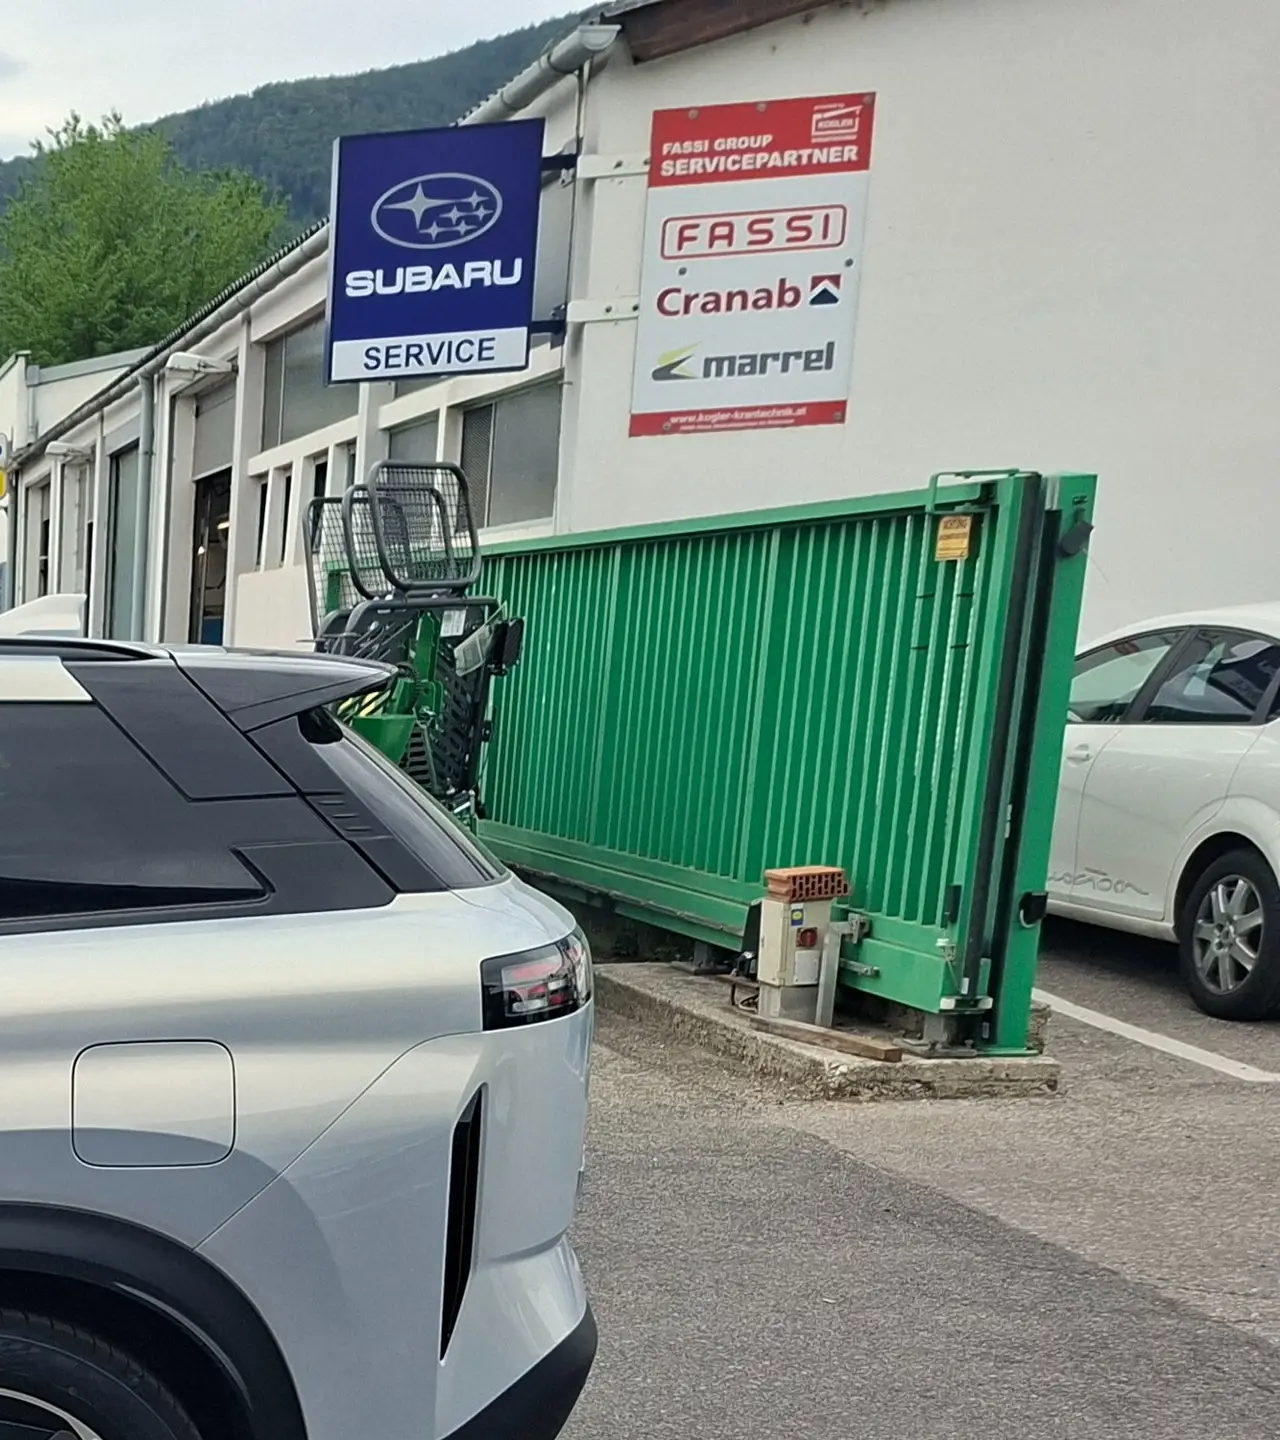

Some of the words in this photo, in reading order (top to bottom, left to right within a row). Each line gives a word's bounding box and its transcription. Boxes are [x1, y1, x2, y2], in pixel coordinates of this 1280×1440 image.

[660, 145, 859, 177] SERVICEPARTNER
[662, 140, 708, 155] FASSI
[714, 134, 773, 151] GROUP
[676, 213, 831, 252] FASSI
[345, 257, 523, 298] SUBARU
[656, 277, 802, 317] Cranab
[363, 336, 496, 371] SERVICE
[702, 340, 836, 379] marrel
